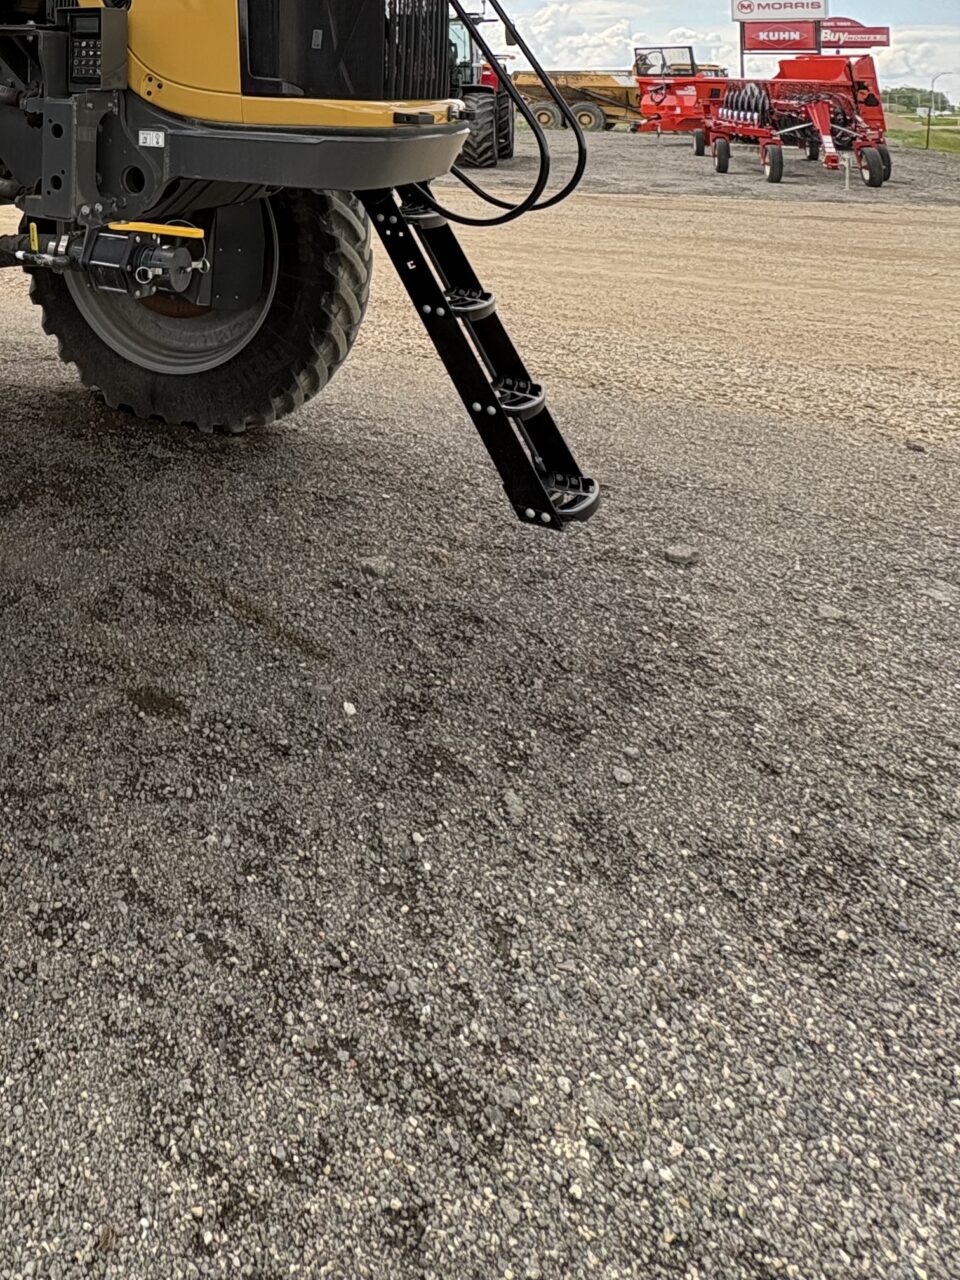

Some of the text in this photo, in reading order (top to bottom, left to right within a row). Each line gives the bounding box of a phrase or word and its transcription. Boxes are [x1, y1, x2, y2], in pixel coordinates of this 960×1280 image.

[757, 1, 822, 11] MORRIS
[758, 31, 800, 41] KUHN
[821, 29, 848, 45] Buy
